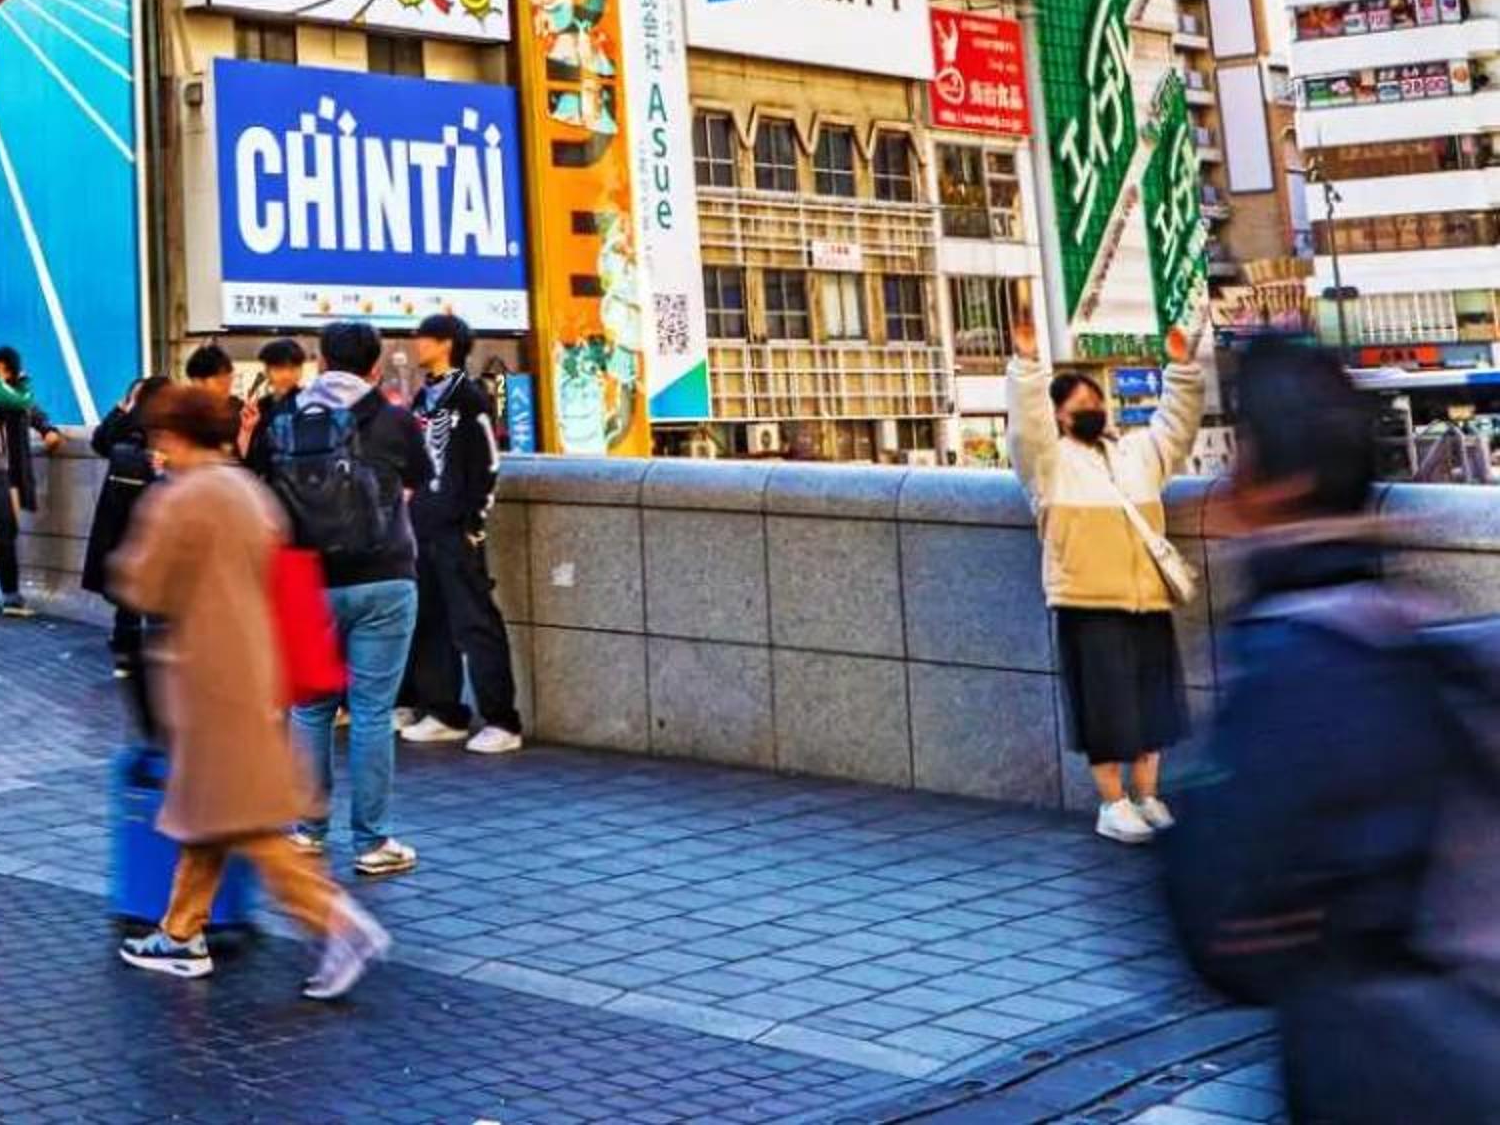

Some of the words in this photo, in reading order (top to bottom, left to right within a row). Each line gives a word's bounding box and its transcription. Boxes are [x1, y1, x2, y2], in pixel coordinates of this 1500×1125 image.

[646, 81, 673, 231] Asue
[1059, 14, 1133, 205] エイブル
